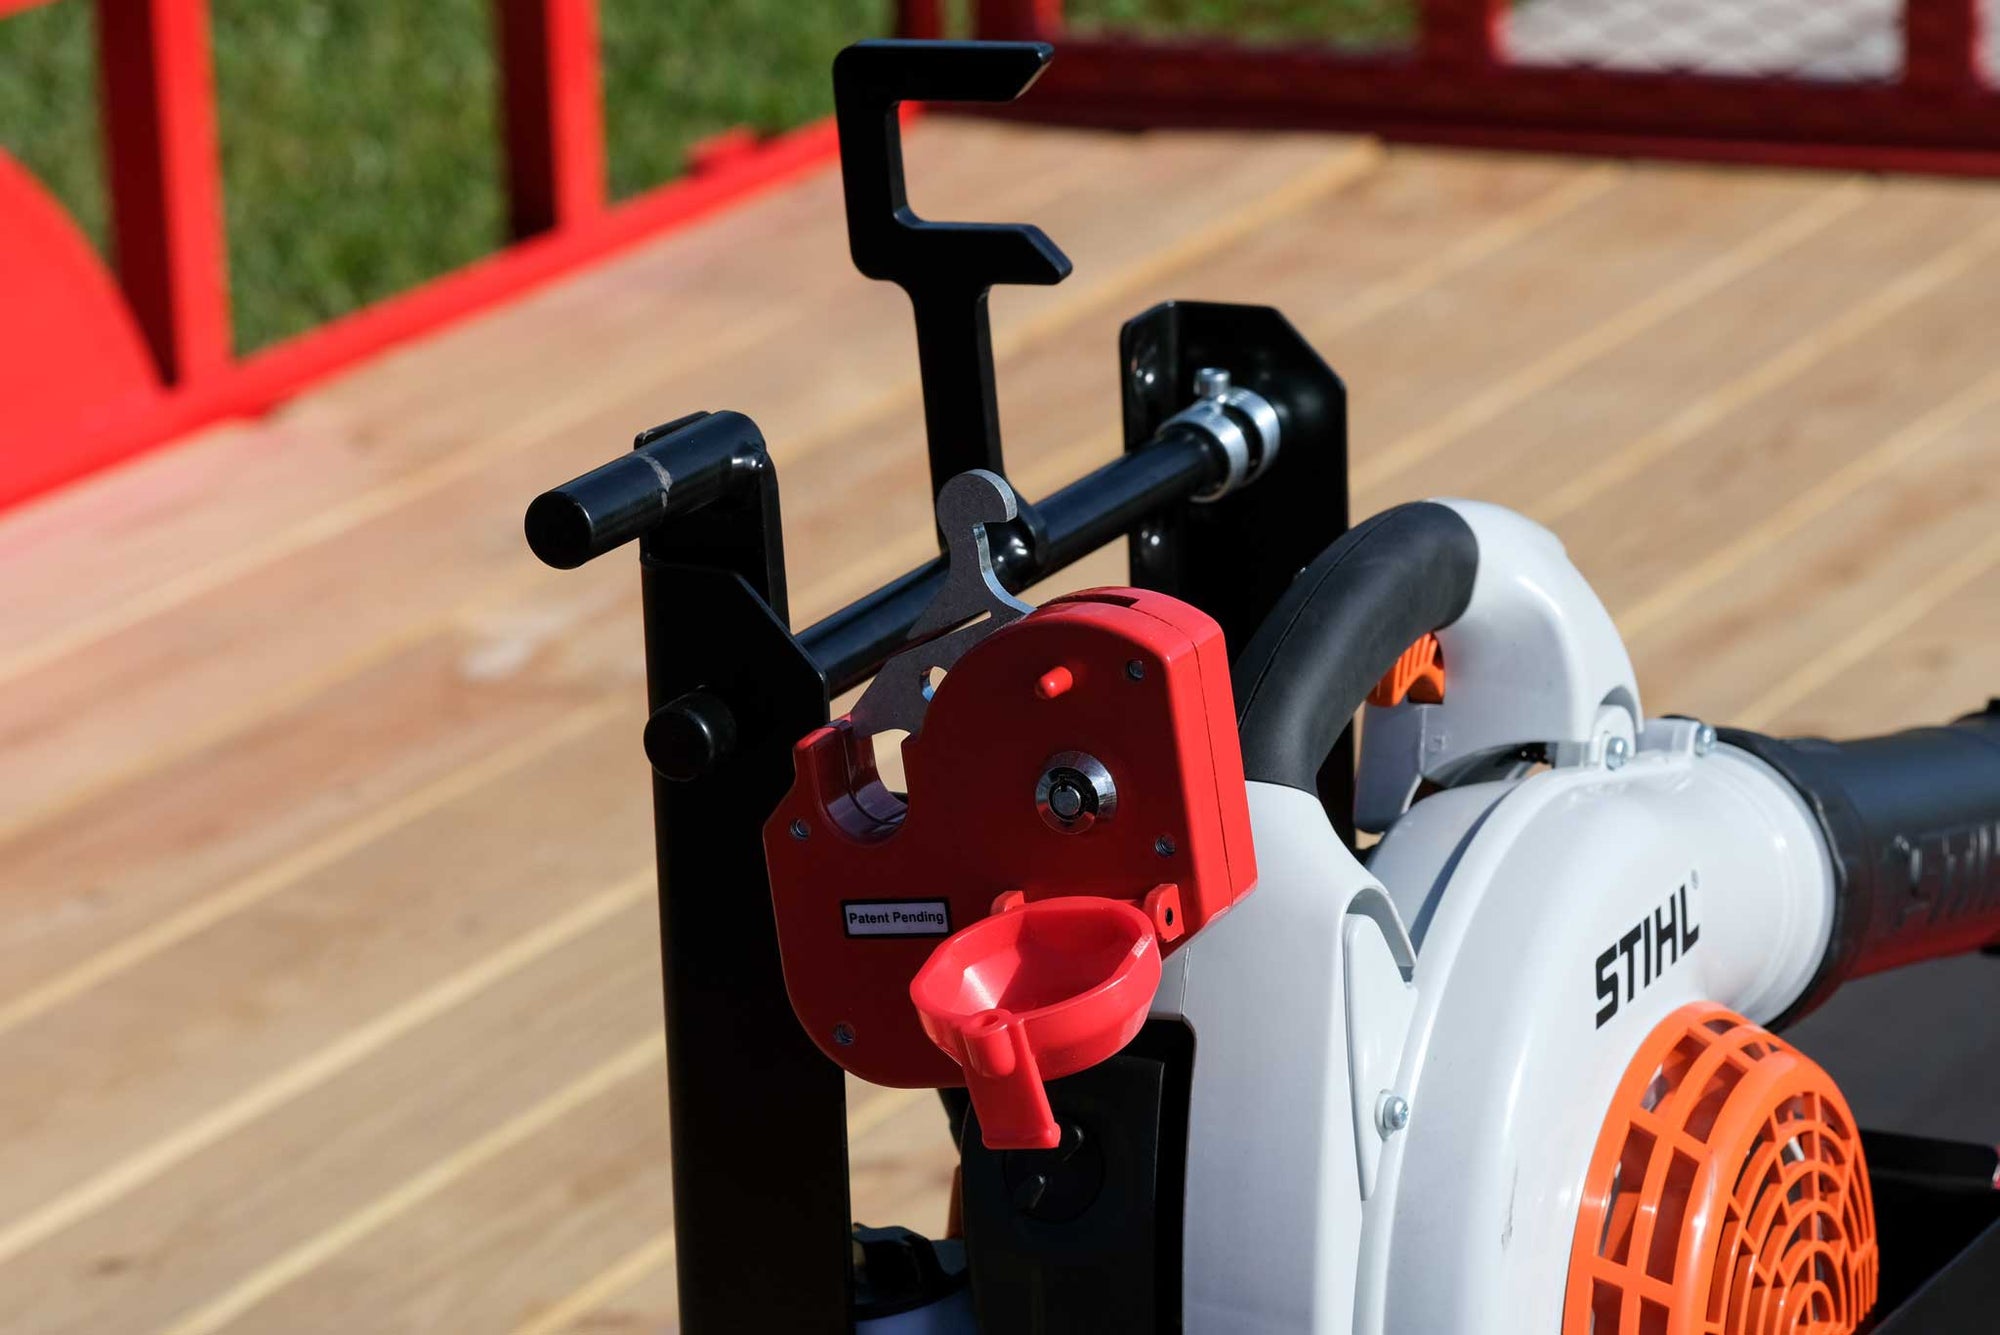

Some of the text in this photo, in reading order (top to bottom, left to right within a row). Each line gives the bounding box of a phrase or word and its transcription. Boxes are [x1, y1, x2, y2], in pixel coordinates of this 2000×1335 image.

[849, 911, 944, 924] Patent Pending
[1595, 883, 1699, 1030] STIHL
